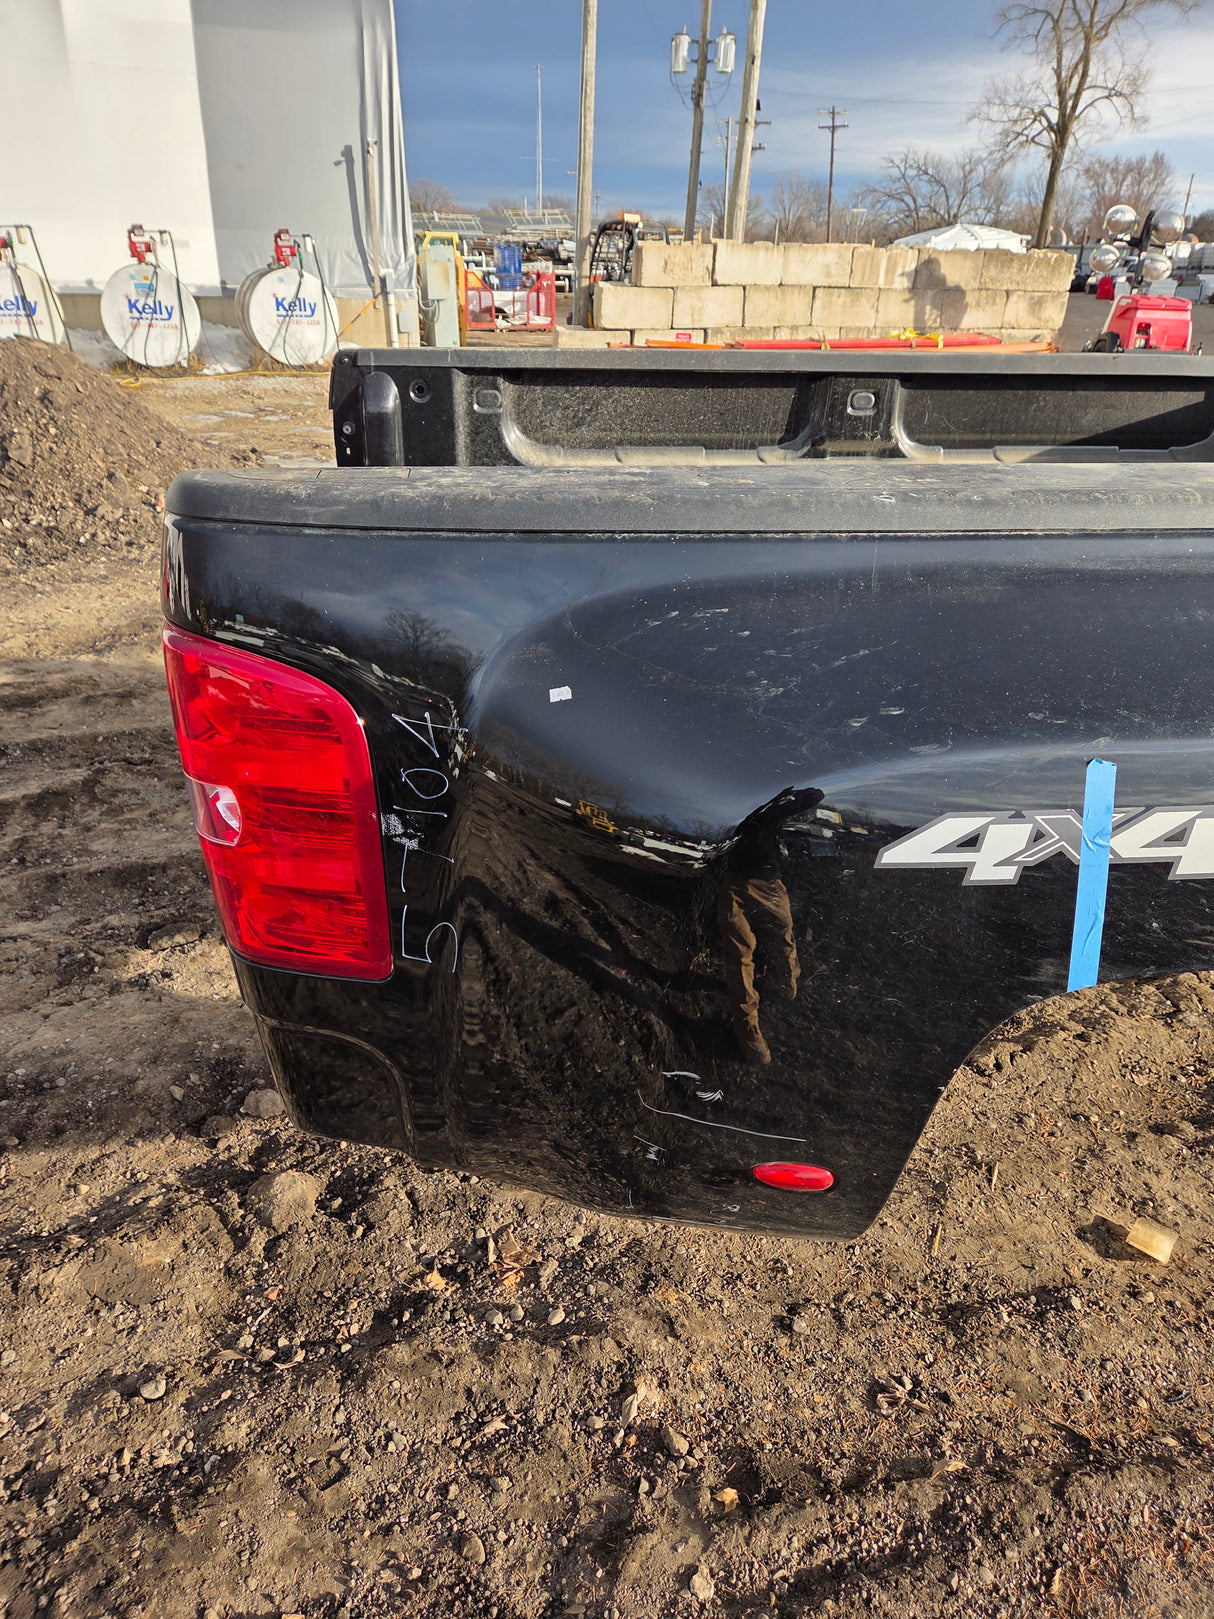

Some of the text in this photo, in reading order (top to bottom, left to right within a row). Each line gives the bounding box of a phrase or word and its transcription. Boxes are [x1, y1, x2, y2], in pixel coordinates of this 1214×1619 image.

[0, 295, 38, 316] elly
[127, 298, 174, 321] Kelly
[274, 297, 317, 317] Kelly
